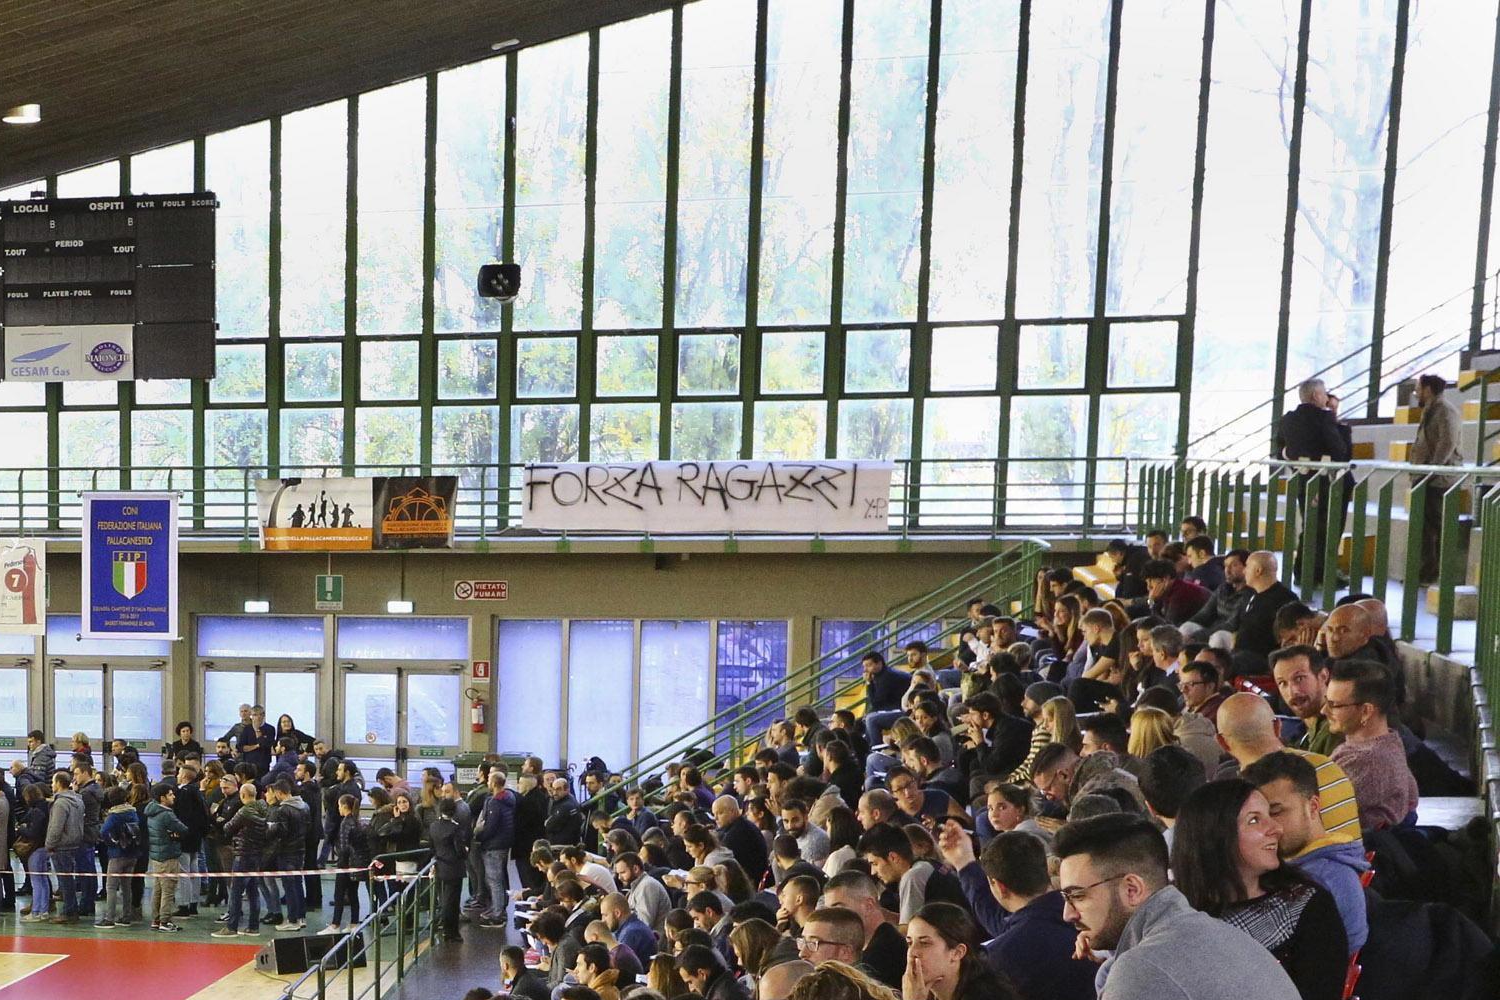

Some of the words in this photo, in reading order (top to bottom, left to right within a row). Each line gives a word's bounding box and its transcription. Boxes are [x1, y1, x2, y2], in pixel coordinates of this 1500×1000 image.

[13, 204, 49, 213] LOCALI
[89, 201, 124, 211] OSPITI
[55, 240, 84, 248] PERIOD
[5, 248, 27, 256] T.OUT
[11, 366, 49, 377] GESAM
[52, 366, 70, 377] Gas
[525, 462, 663, 511] FORZA
[677, 462, 858, 511] RAGAZZI
[122, 506, 138, 515] CONI
[97, 521, 136, 530] FEDERAZIONE
[137, 521, 162, 530] ITALIANA
[107, 536, 153, 545] PALLACANESTRO
[11, 574, 21, 588] 7
